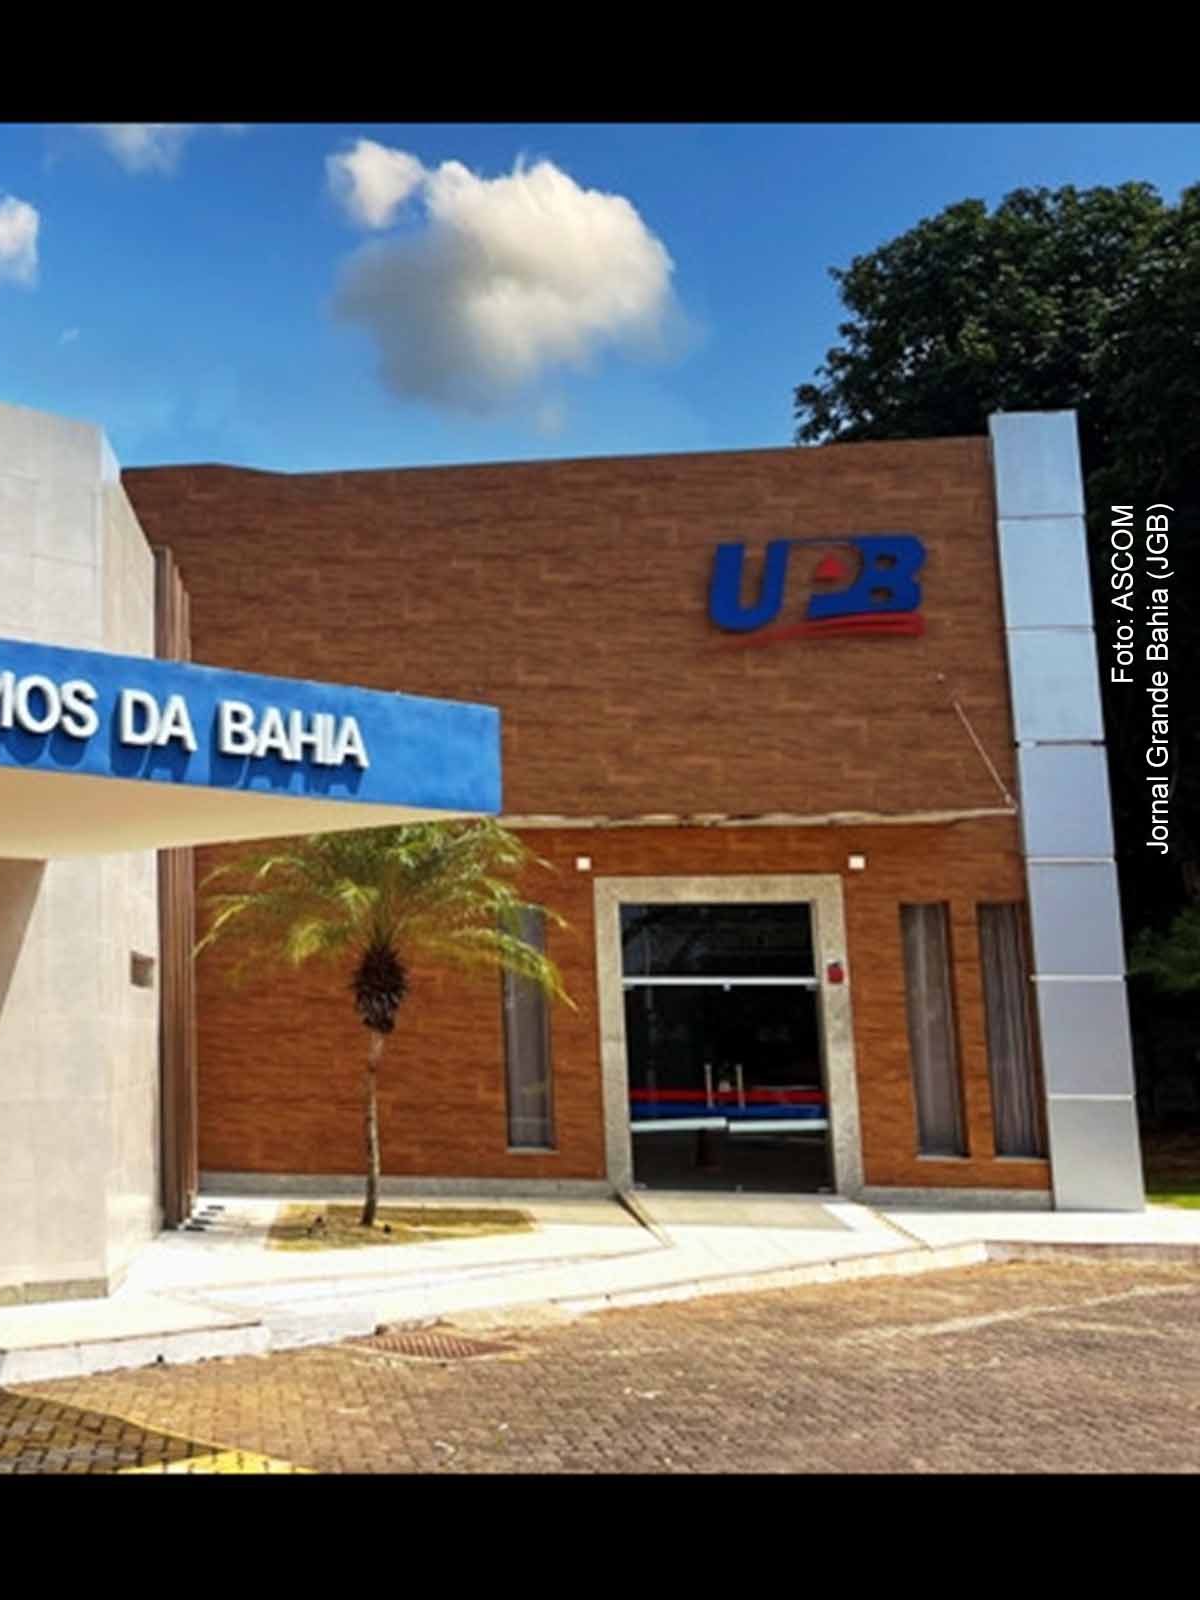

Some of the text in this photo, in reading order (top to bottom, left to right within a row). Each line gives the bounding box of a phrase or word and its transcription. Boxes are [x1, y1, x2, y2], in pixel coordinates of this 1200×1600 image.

[708, 535, 927, 632] UPB
[119, 689, 198, 752] DA
[220, 699, 369, 769] BAHIA
